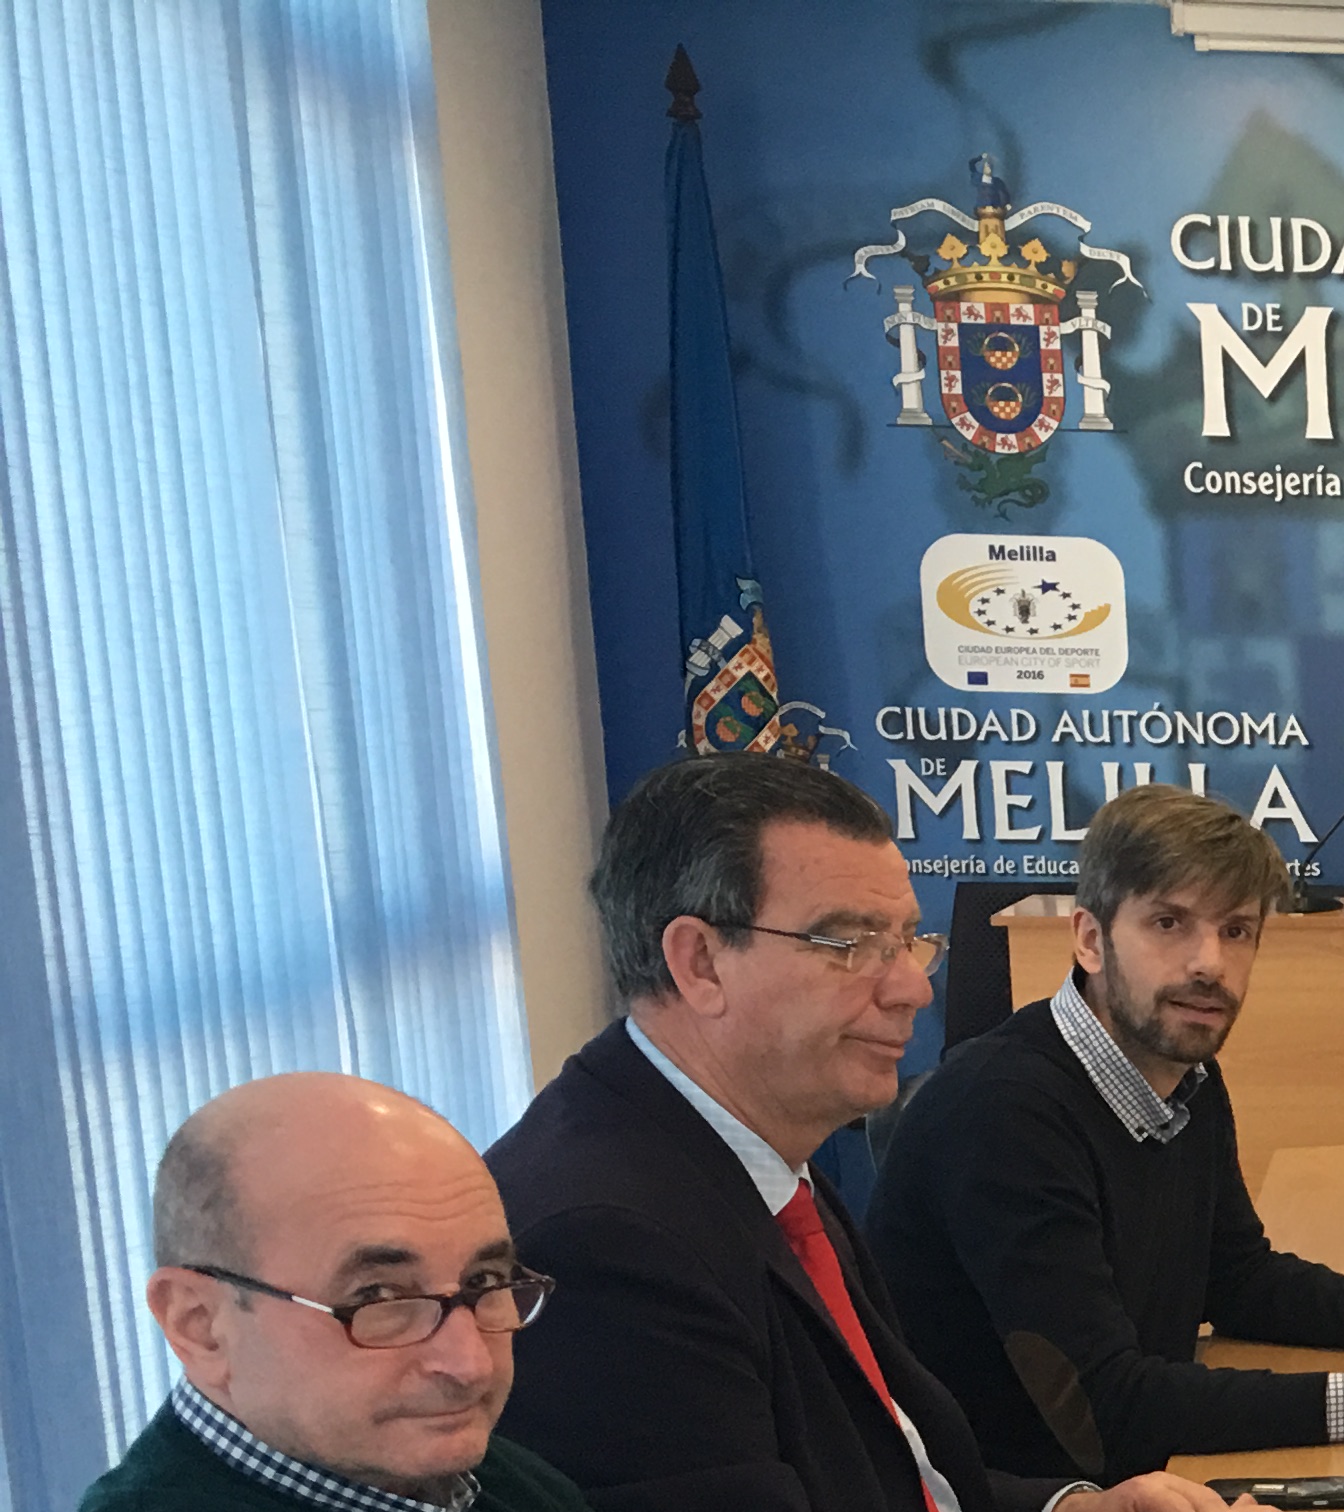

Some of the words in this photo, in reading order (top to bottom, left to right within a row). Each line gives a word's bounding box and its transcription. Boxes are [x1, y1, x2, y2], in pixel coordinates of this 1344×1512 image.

[1242, 304, 1283, 332] DE
[1185, 461, 1342, 501] Consejería
[988, 544, 1056, 563] Melilla
[958, 645, 993, 655] CIUDAD
[996, 646, 1038, 656] EUROPEA
[1040, 647, 1056, 656] DEL
[1059, 647, 1100, 657] DEPORTE
[1016, 670, 1044, 680] 2016
[876, 706, 1037, 743] CIUDAD
[1052, 702, 1309, 746] AUTÓNOMA
[921, 758, 946, 777] DE
[904, 856, 985, 879] onsejería
[994, 856, 1016, 874] de
